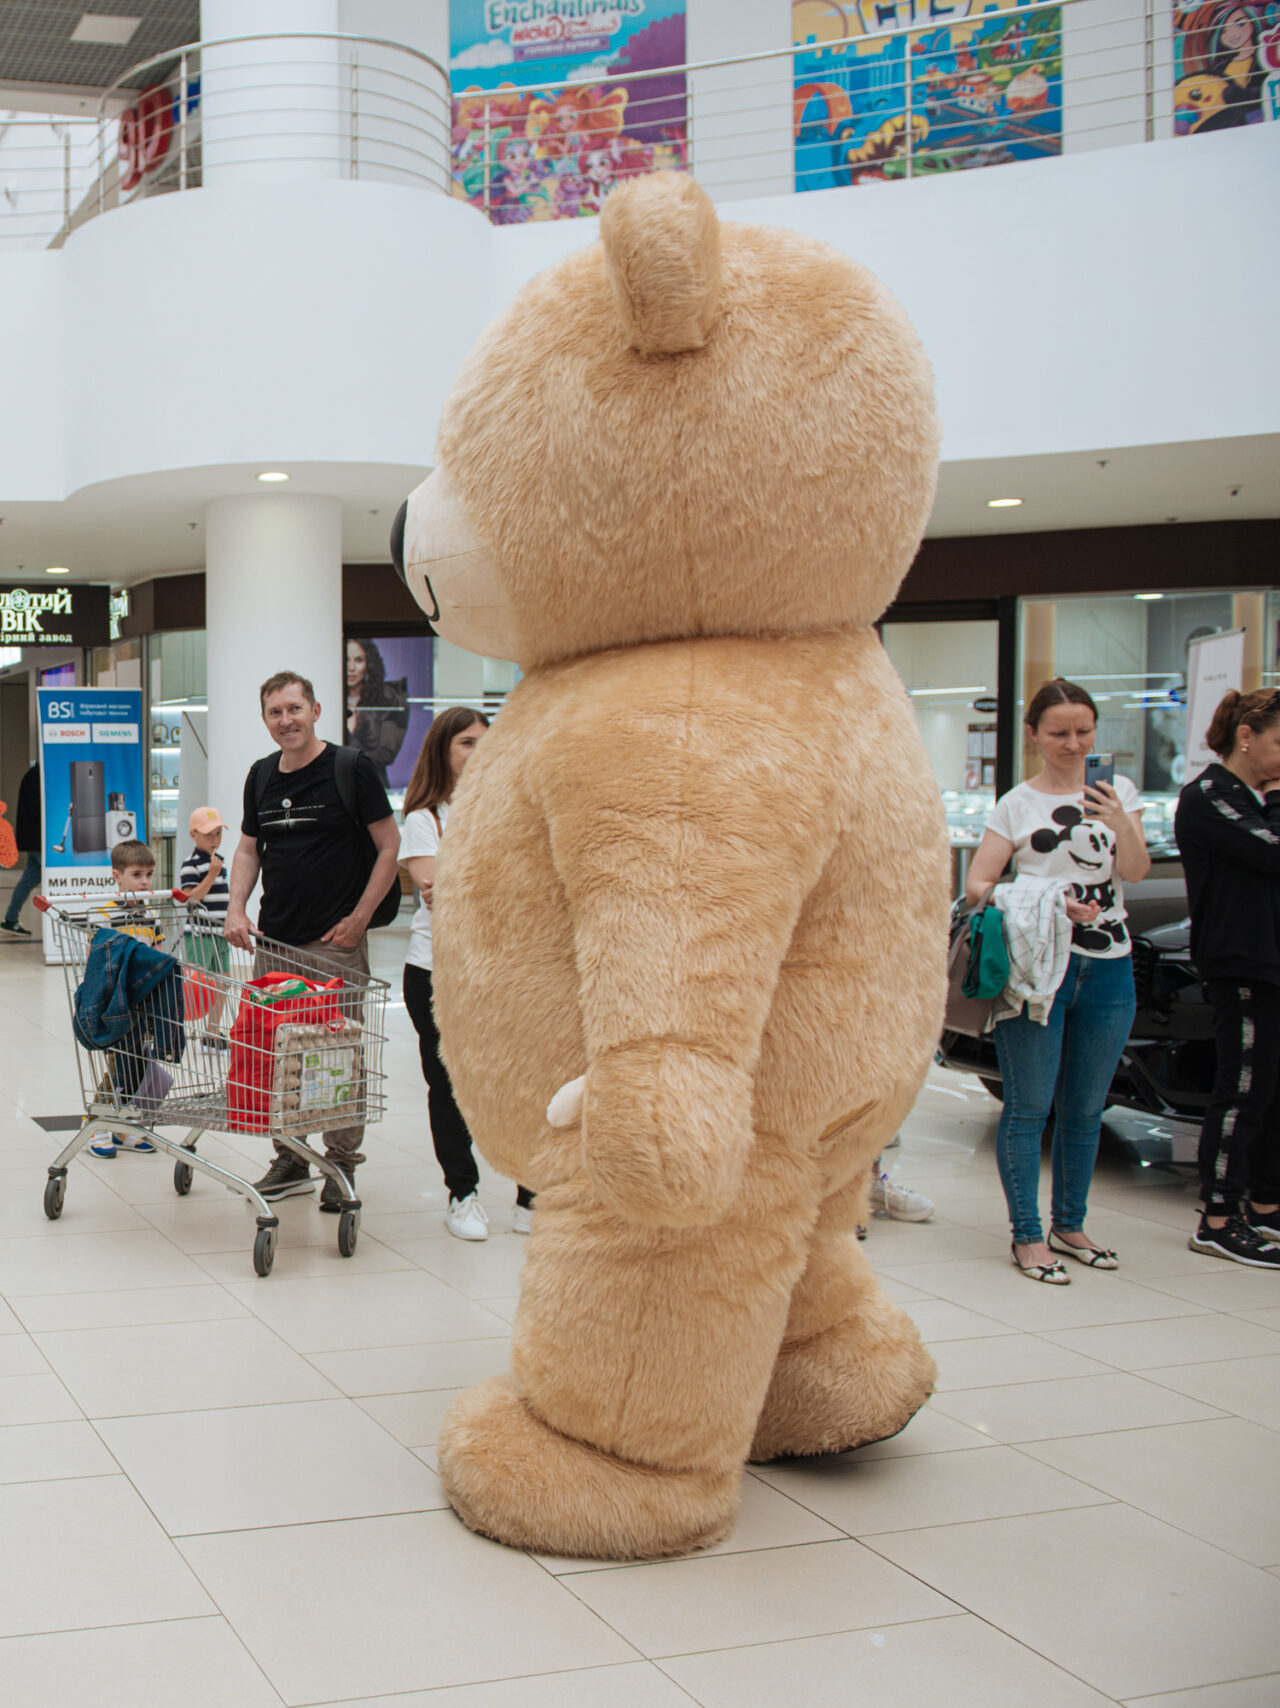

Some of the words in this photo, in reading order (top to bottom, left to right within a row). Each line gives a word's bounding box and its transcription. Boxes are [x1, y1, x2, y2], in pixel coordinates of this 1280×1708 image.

[39, 633, 73, 643] завод
[48, 877, 68, 887] МИ
[71, 876, 116, 888] ПРАЦЮ
